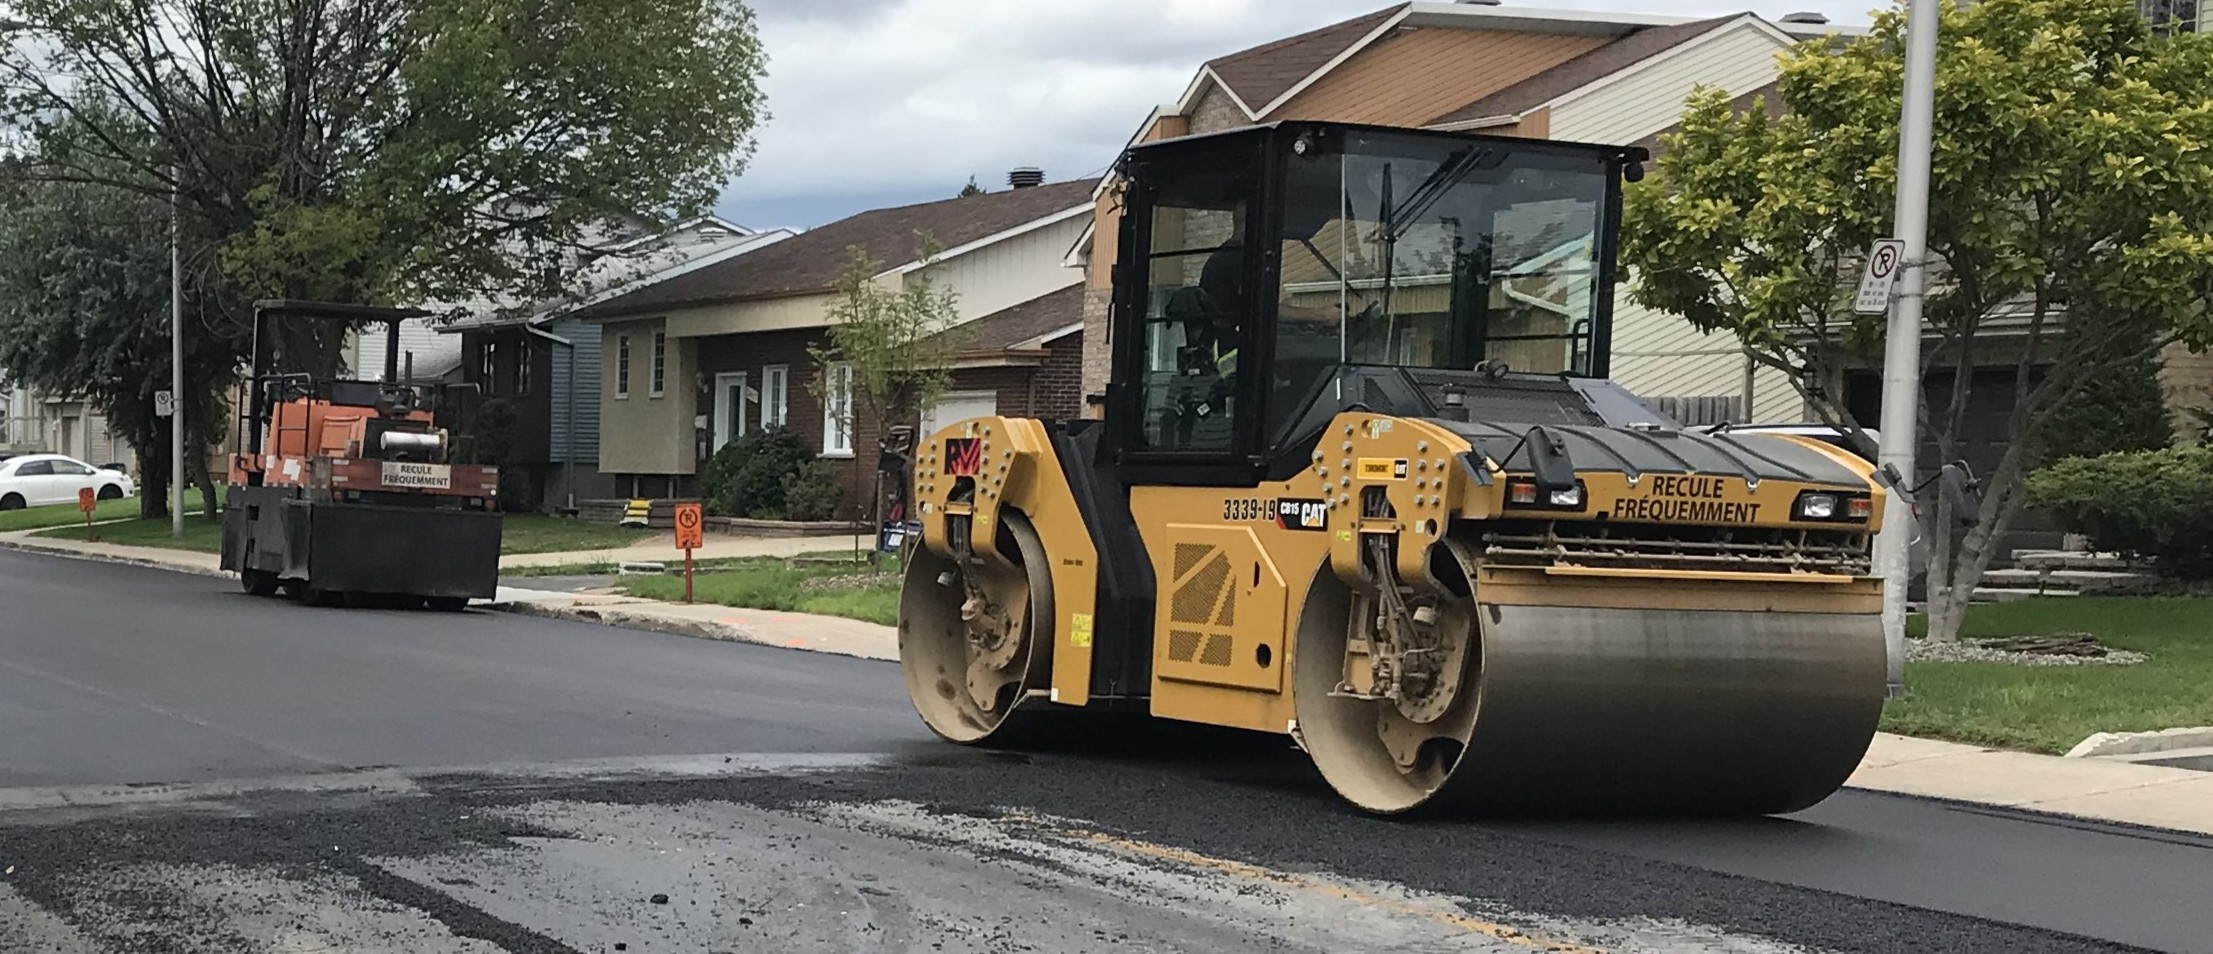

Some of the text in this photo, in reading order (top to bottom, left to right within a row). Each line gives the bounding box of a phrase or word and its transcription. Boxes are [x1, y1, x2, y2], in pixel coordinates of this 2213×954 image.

[384, 474, 449, 486] FRÉQUEMMENT
[400, 465, 432, 474] RECULE
[1652, 476, 1724, 498] RECULE
[1223, 499, 1276, 520] 3339-19
[1301, 503, 1327, 527] CAT
[1614, 495, 1761, 523] FRÉQUEMMENT
